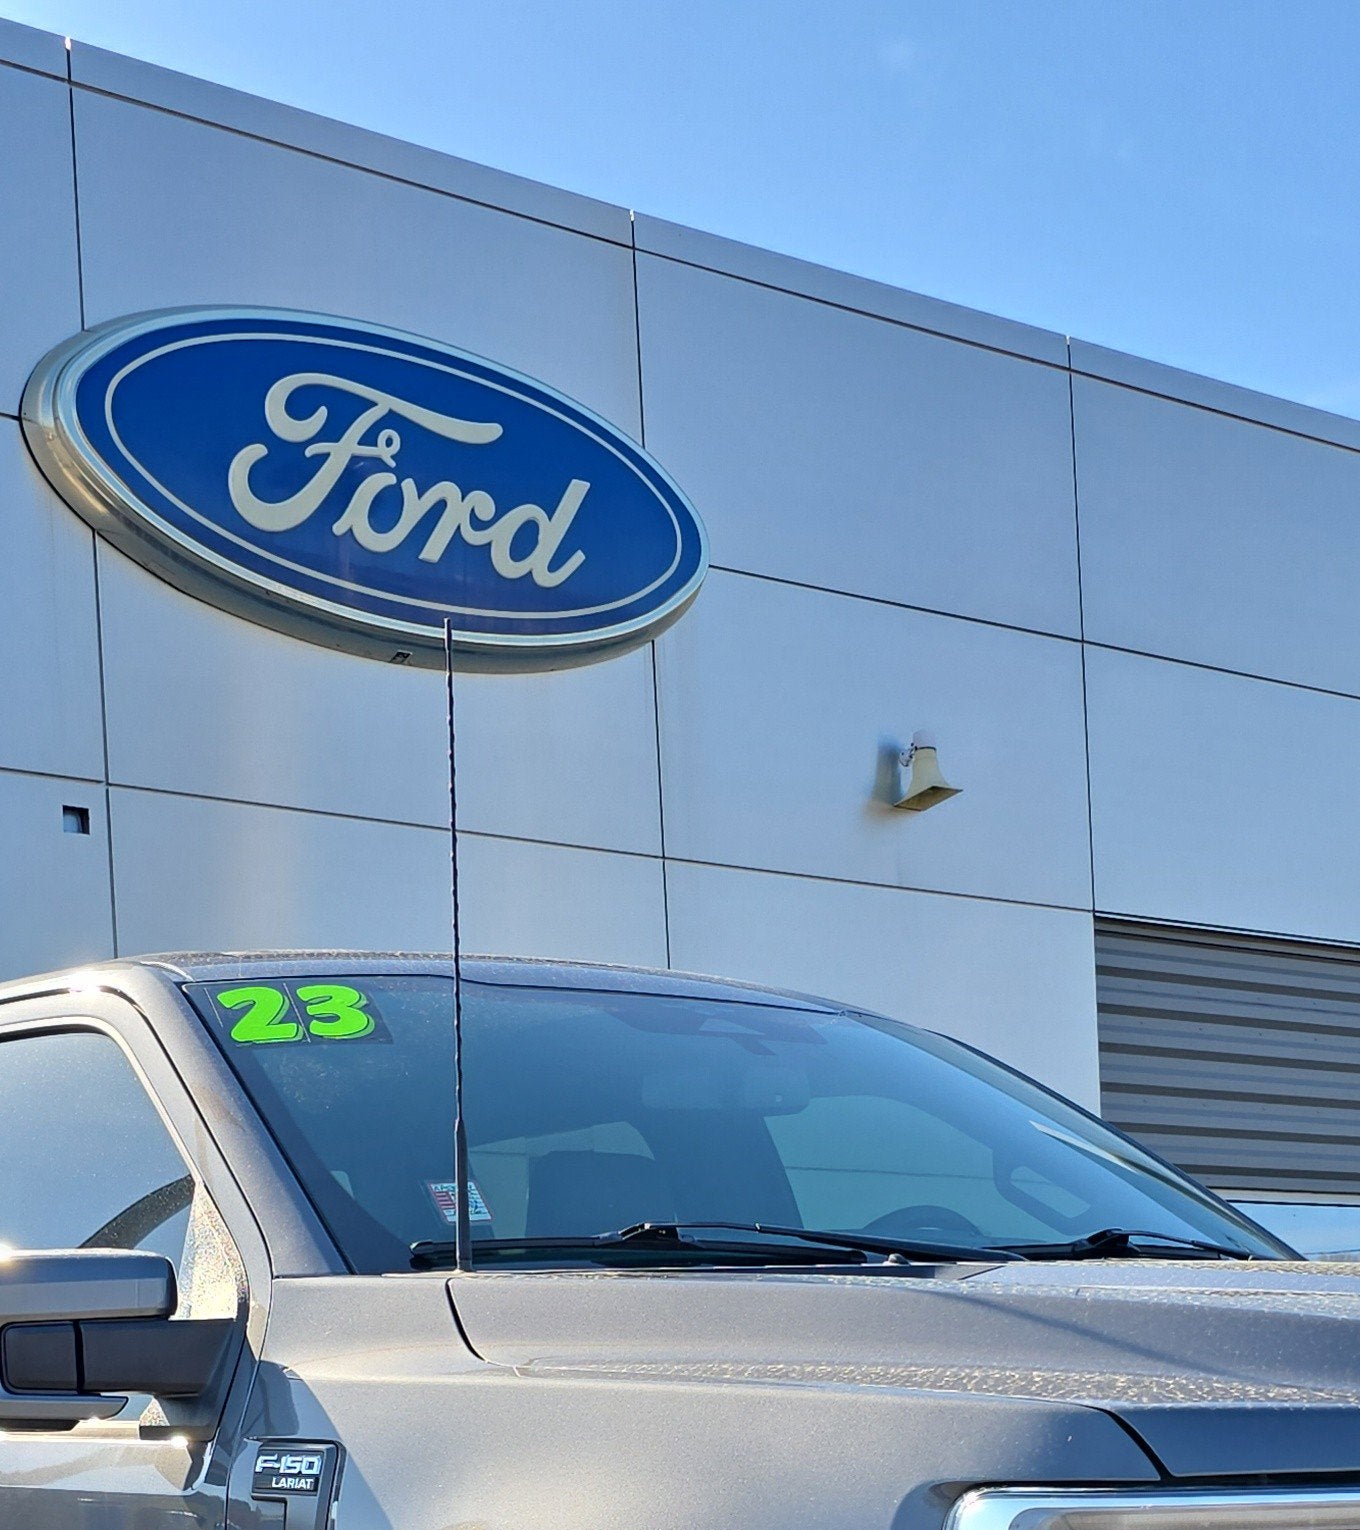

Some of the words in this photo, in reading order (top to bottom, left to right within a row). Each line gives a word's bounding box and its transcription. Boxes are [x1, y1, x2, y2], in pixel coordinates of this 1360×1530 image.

[228, 372, 591, 588] Ford
[216, 984, 376, 1043] 23
[254, 1453, 323, 1475] F-150
[271, 1477, 315, 1489] LARIAT
